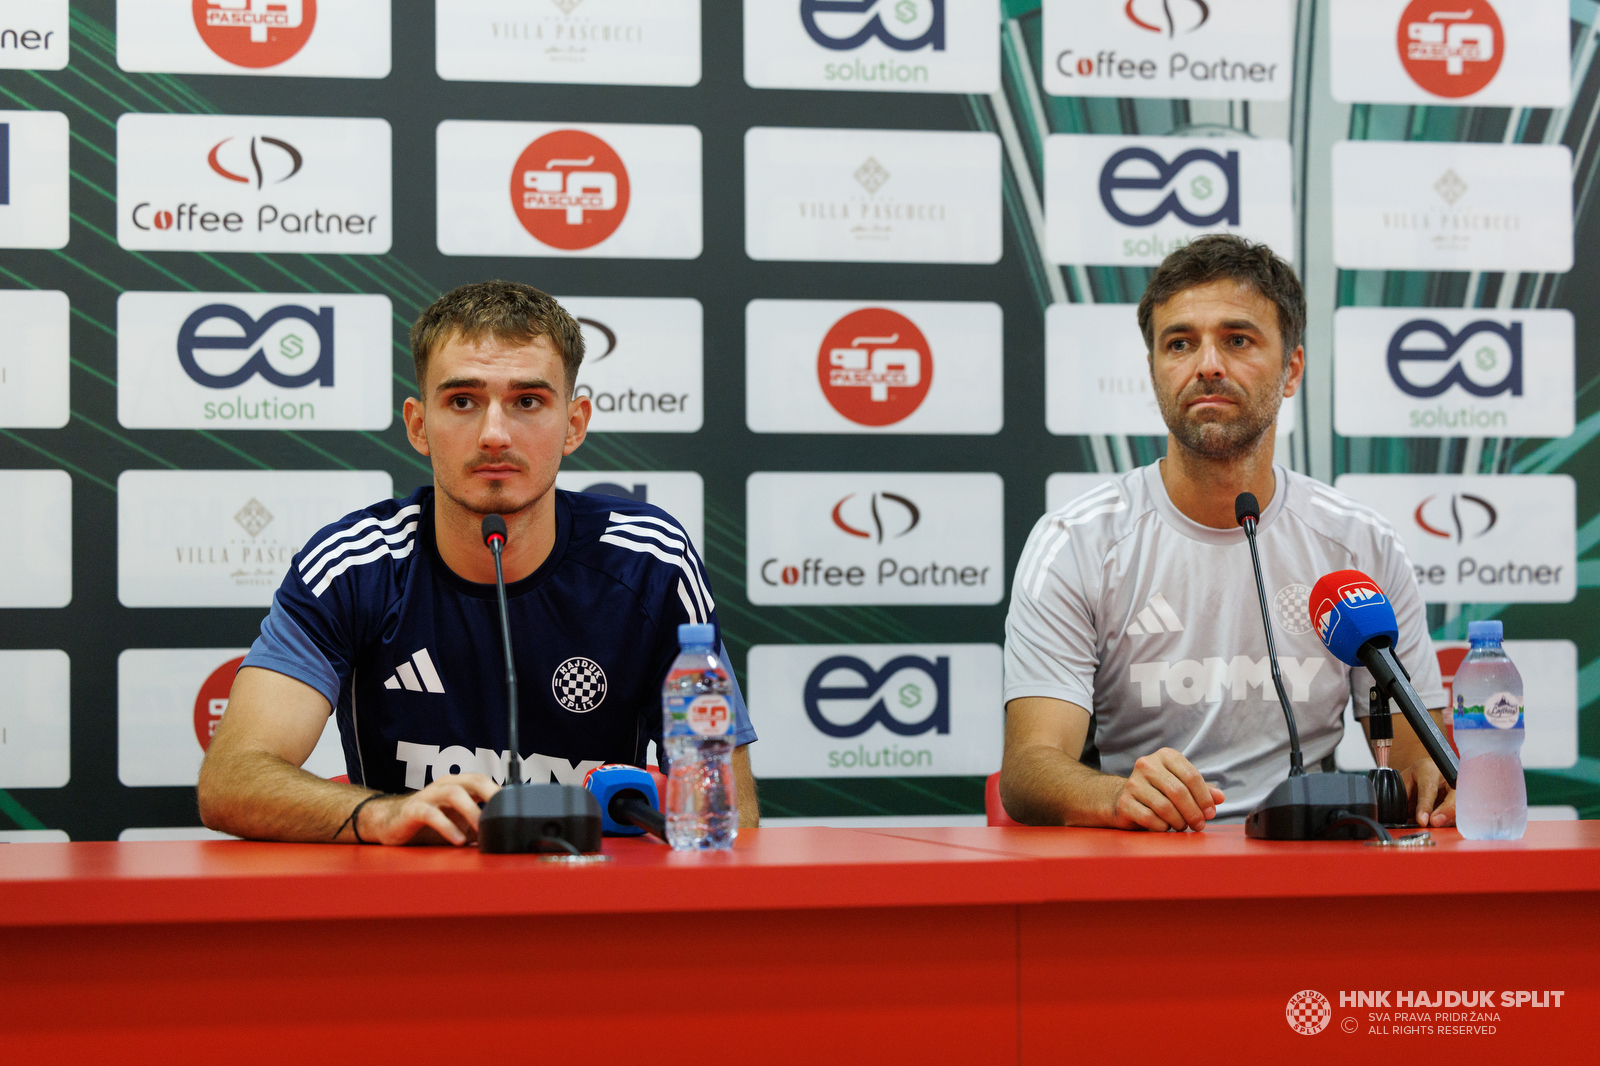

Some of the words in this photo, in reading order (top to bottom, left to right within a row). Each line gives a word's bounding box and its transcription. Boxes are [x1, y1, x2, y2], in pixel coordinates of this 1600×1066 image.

[208, 12, 289, 25] PASCUCCI
[492, 22, 543, 40] VILLA
[555, 24, 643, 42] PASCUCCI
[824, 58, 929, 82] solution
[1056, 49, 1157, 79] Coffee
[1169, 52, 1278, 82] Partner
[131, 202, 244, 232] Coffee
[258, 204, 377, 235] Partner
[799, 202, 849, 219] VILLA
[860, 203, 946, 221] PASCUCCI
[204, 396, 315, 420] solution
[1409, 404, 1507, 428] solution
[176, 547, 229, 564] VILLA
[761, 558, 865, 587] Coffee
[878, 558, 990, 587] Partner
[1457, 557, 1563, 586] Partner
[559, 659, 603, 680] HAJDUK
[1130, 655, 1326, 707] TOMMY
[560, 696, 594, 711] SPLIT
[828, 744, 933, 768] solution
